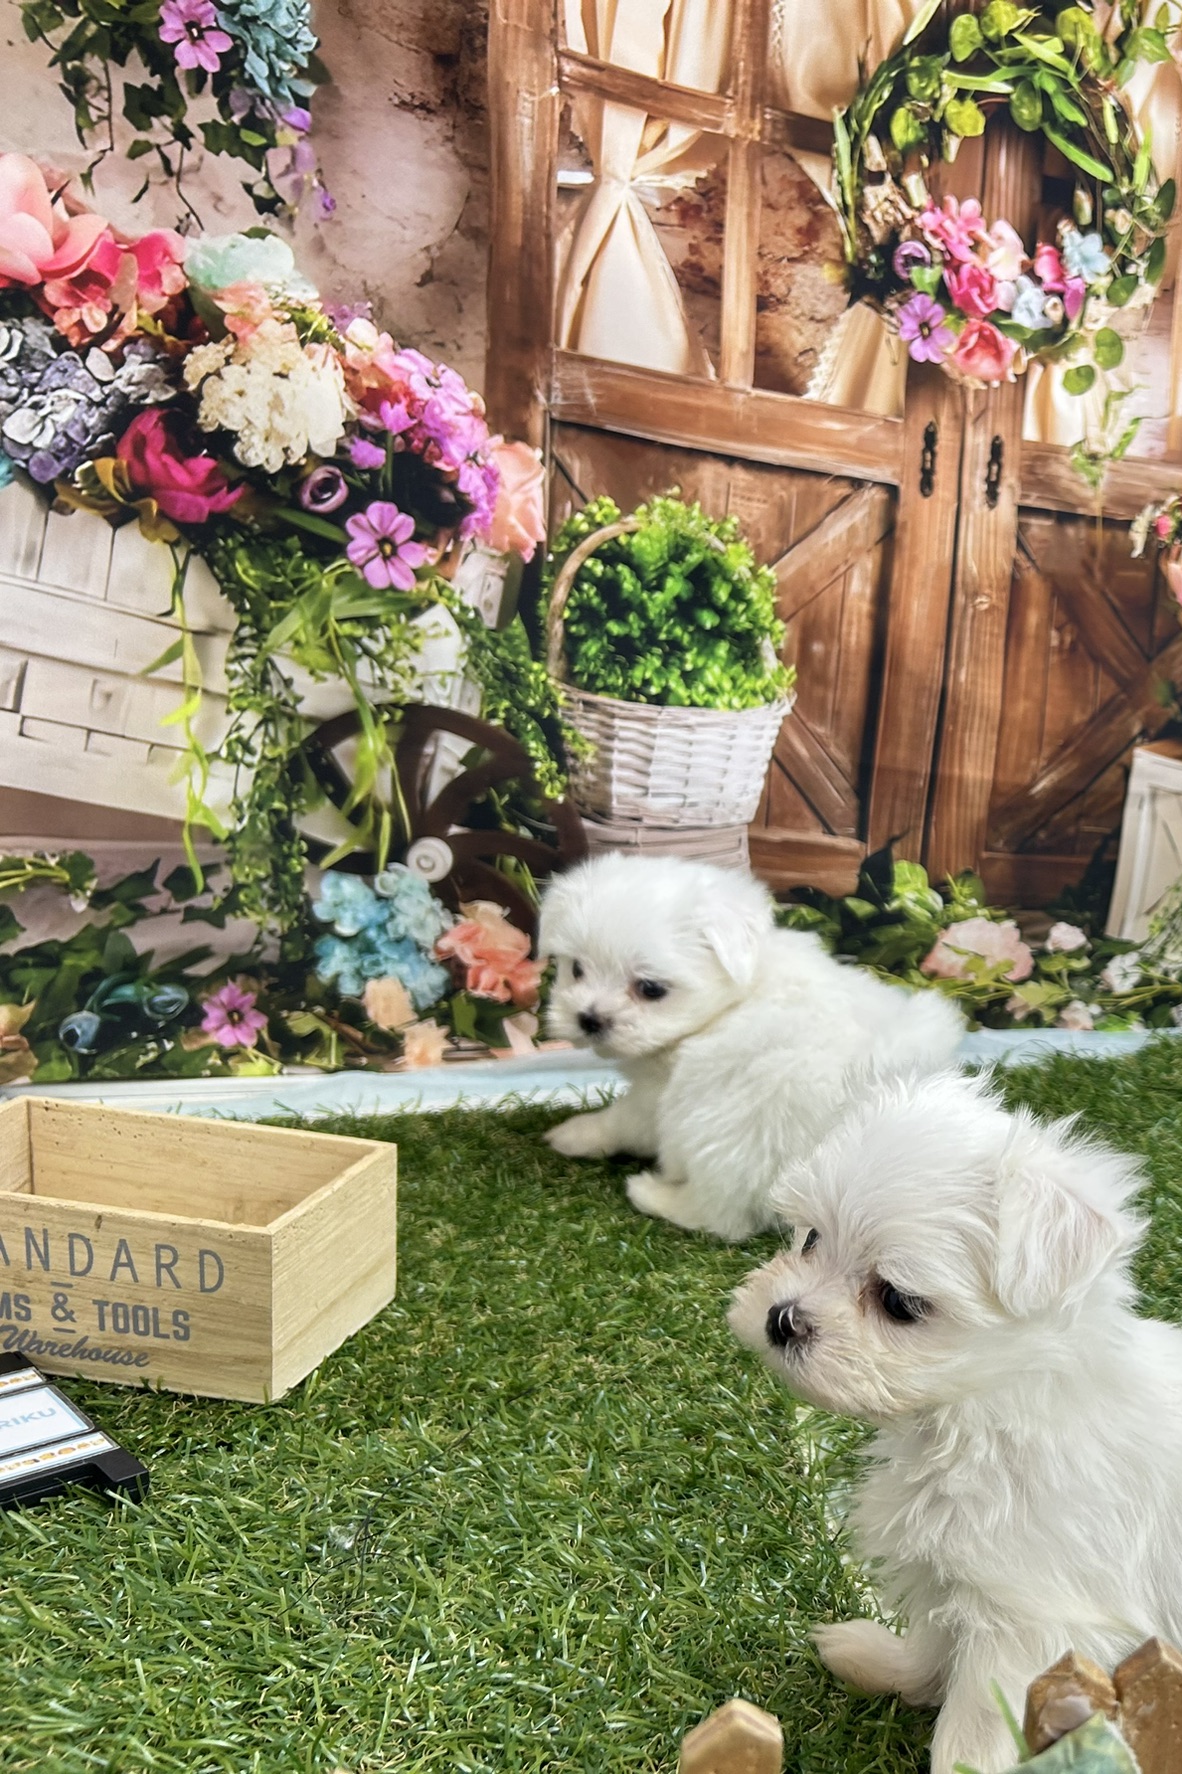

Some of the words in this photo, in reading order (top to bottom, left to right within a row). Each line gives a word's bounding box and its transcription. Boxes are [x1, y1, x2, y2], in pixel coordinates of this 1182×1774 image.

[51, 1292, 77, 1323] &
[92, 1299, 191, 1341] TOOLS
[0, 1324, 151, 1367] Warehouse
